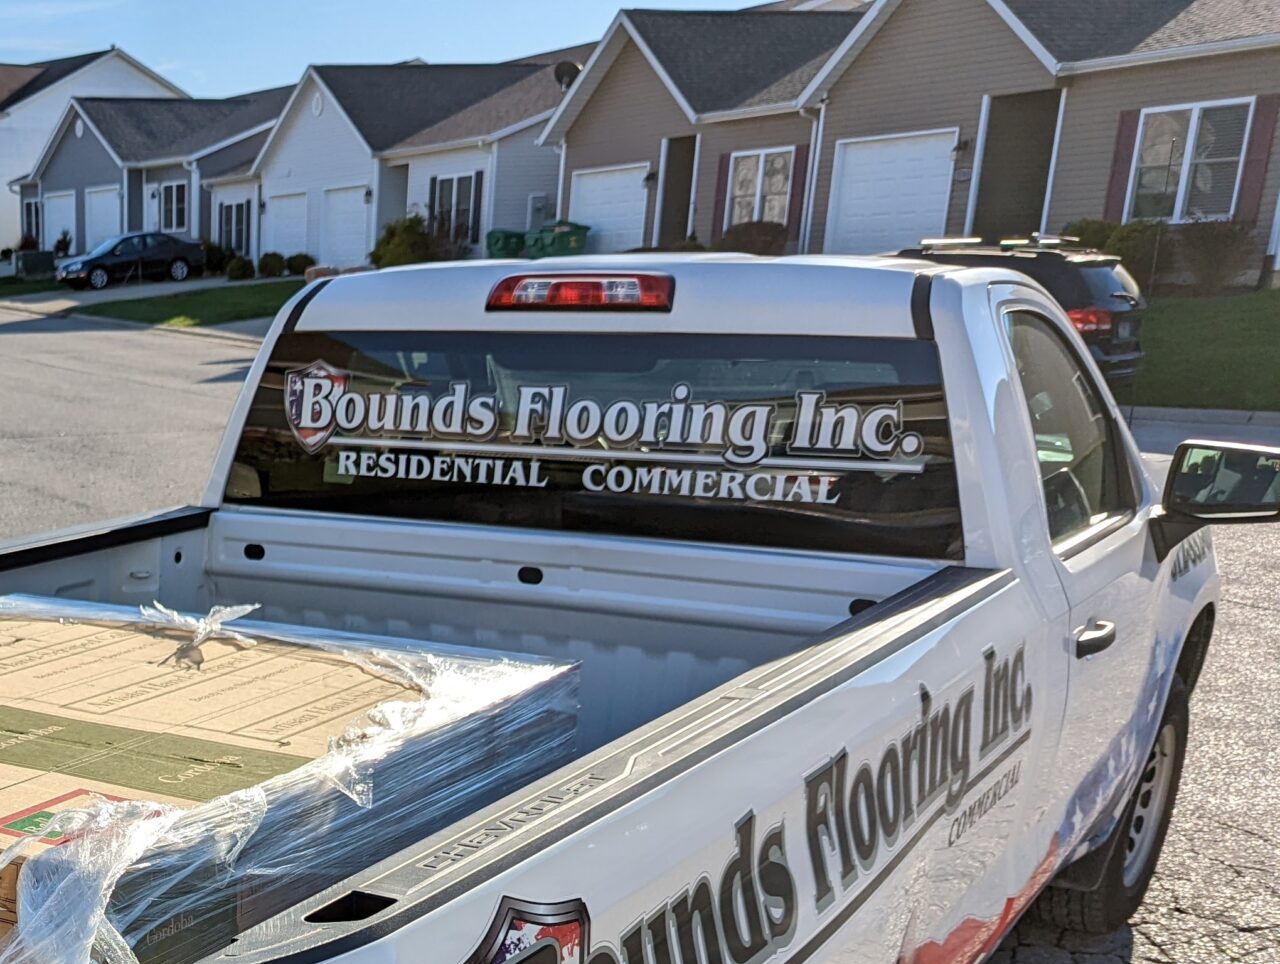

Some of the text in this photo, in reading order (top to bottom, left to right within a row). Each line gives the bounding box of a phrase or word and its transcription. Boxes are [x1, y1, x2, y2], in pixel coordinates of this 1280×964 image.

[299, 376, 922, 465] Bounds Flooring Inc.
[337, 451, 841, 505] RESIDENTIAL COMMERCIAL
[804, 681, 976, 918] Flooring
[979, 643, 1033, 761] Inc.
[948, 759, 1022, 847] COMMERCIAL
[147, 914, 194, 946] Cordoba
